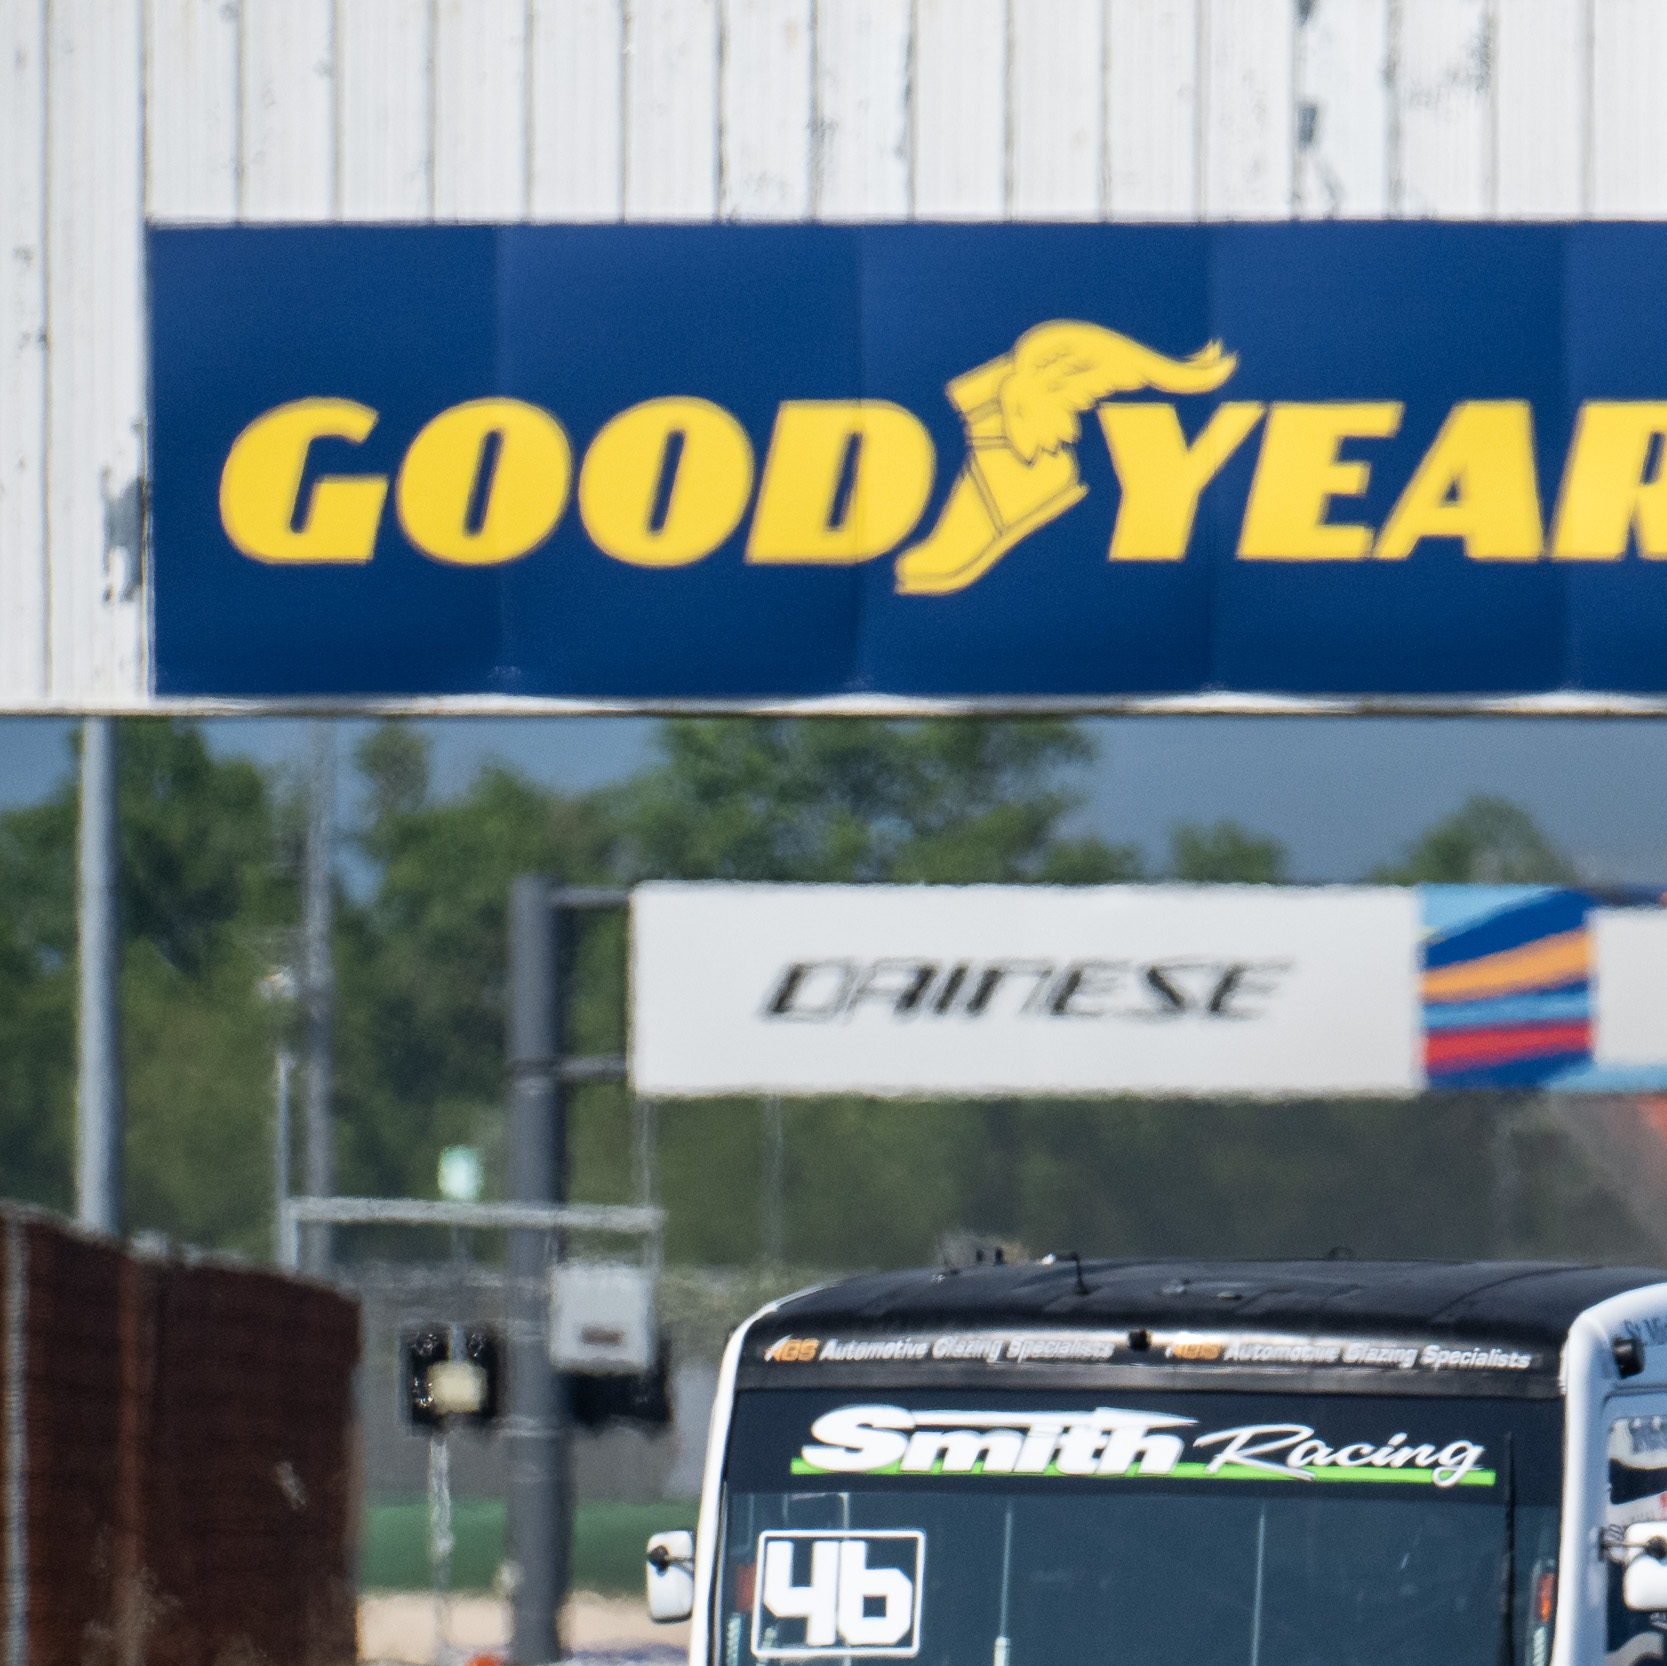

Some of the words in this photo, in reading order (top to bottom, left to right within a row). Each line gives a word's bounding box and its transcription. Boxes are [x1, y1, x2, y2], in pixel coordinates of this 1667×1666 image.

[819, 1337, 930, 1362] Automotive
[931, 1336, 1002, 1364] Glazing
[1005, 1334, 1116, 1365] Specialists
[1224, 1340, 1339, 1364] Automotive
[1342, 1342, 1418, 1369] Glazing
[1420, 1344, 1533, 1371] Specialists
[800, 1403, 1200, 1476] Smith
[1192, 1423, 1486, 1489] Racing
[762, 1536, 915, 1647] 46
